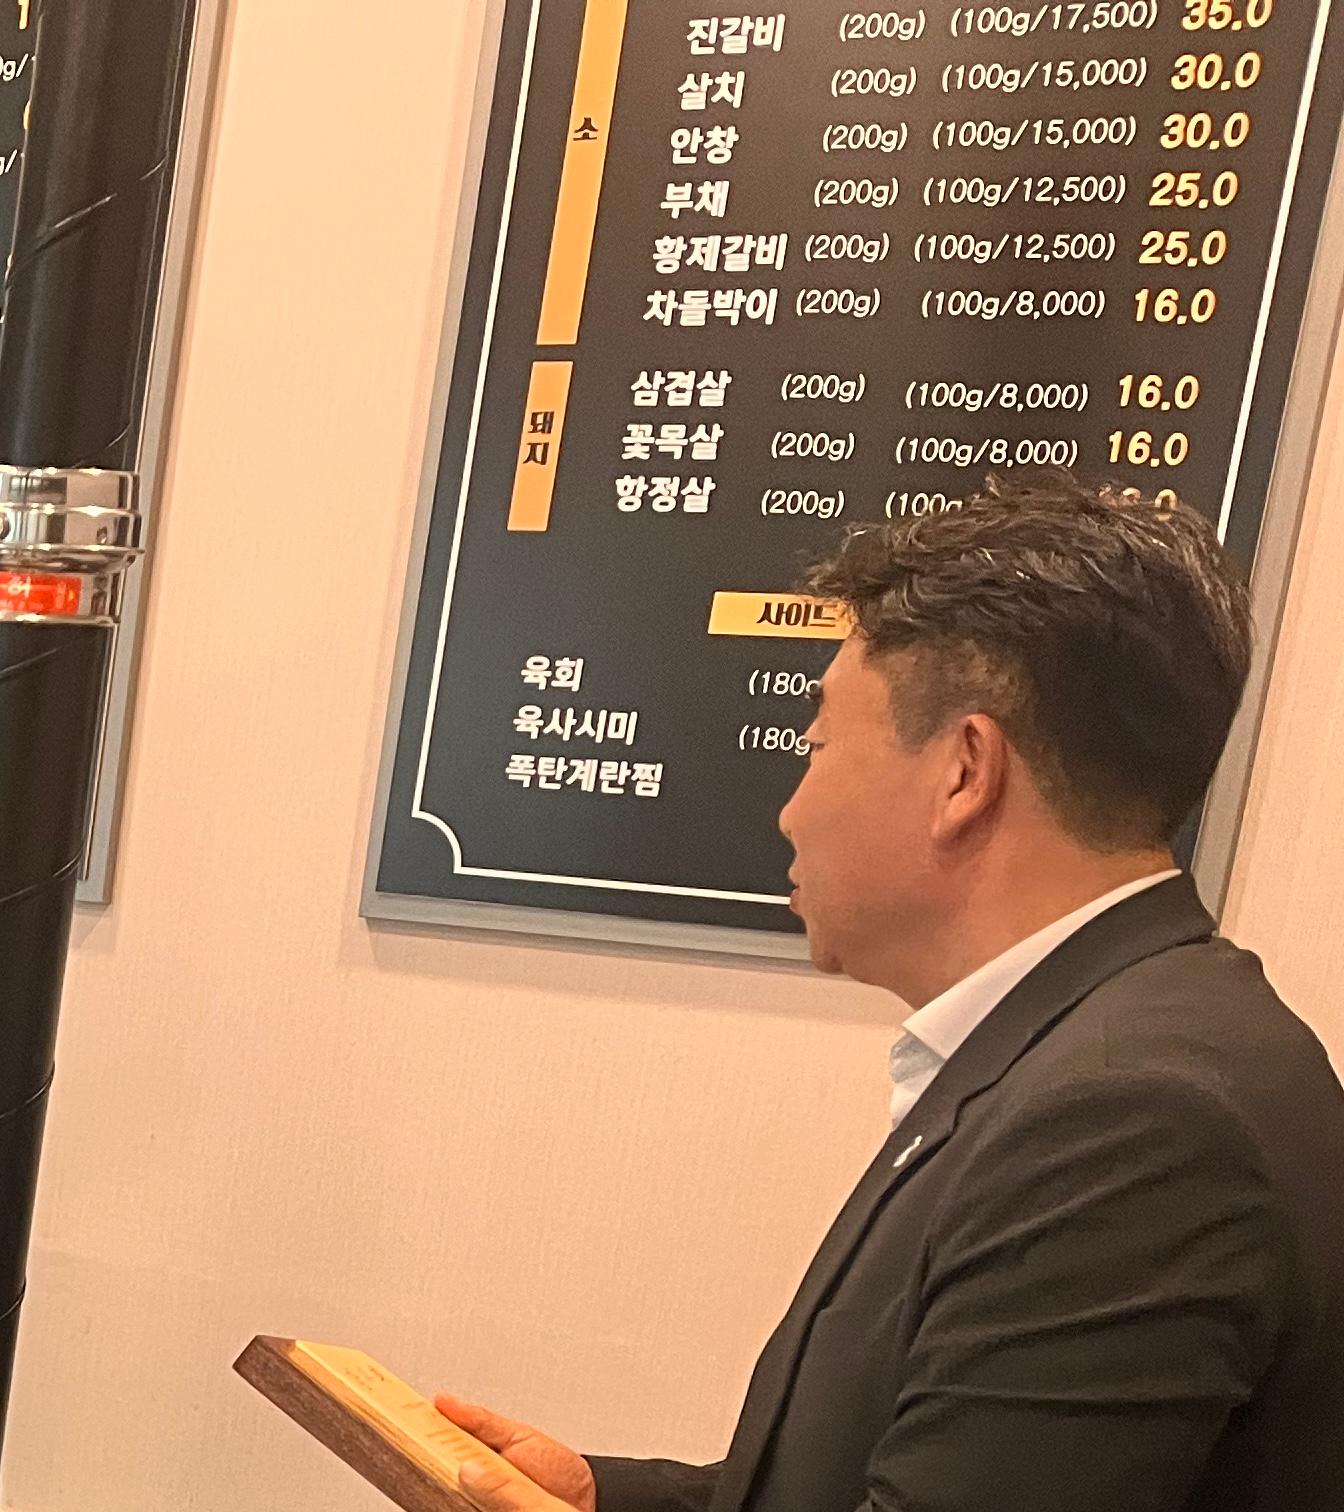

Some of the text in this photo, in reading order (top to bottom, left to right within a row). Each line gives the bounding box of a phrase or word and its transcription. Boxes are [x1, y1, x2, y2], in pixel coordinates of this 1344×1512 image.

[686, 0, 1272, 55] 진갈비 (200g) (100g/17,500) 35.0
[678, 52, 1260, 110] 살치 (200g) (100g/15,000) 30.0
[671, 112, 1249, 164] 안창 (200g) (100g/15,000) 30.0
[660, 172, 1238, 219] 부채 (200g) (100g/12,500) 25.0
[653, 231, 1226, 273] 황제갈비 (200g) (100g/12,500) 25.0
[643, 288, 1216, 326] 차돌박이 (200g) (100g/8,000) 16.0
[631, 371, 1199, 411] 삼겹살 (200g) (100g/8,000) 16.0
[523, 410, 554, 467] 돼지
[622, 424, 1188, 467] 꽃목살 (200g) (100g/8,000) 16.0
[616, 475, 715, 512] 항정살
[762, 490, 844, 518] (200g)
[521, 656, 583, 691] 육회
[513, 705, 637, 745] 육사시미
[506, 755, 662, 796] 폭탄계란찜
